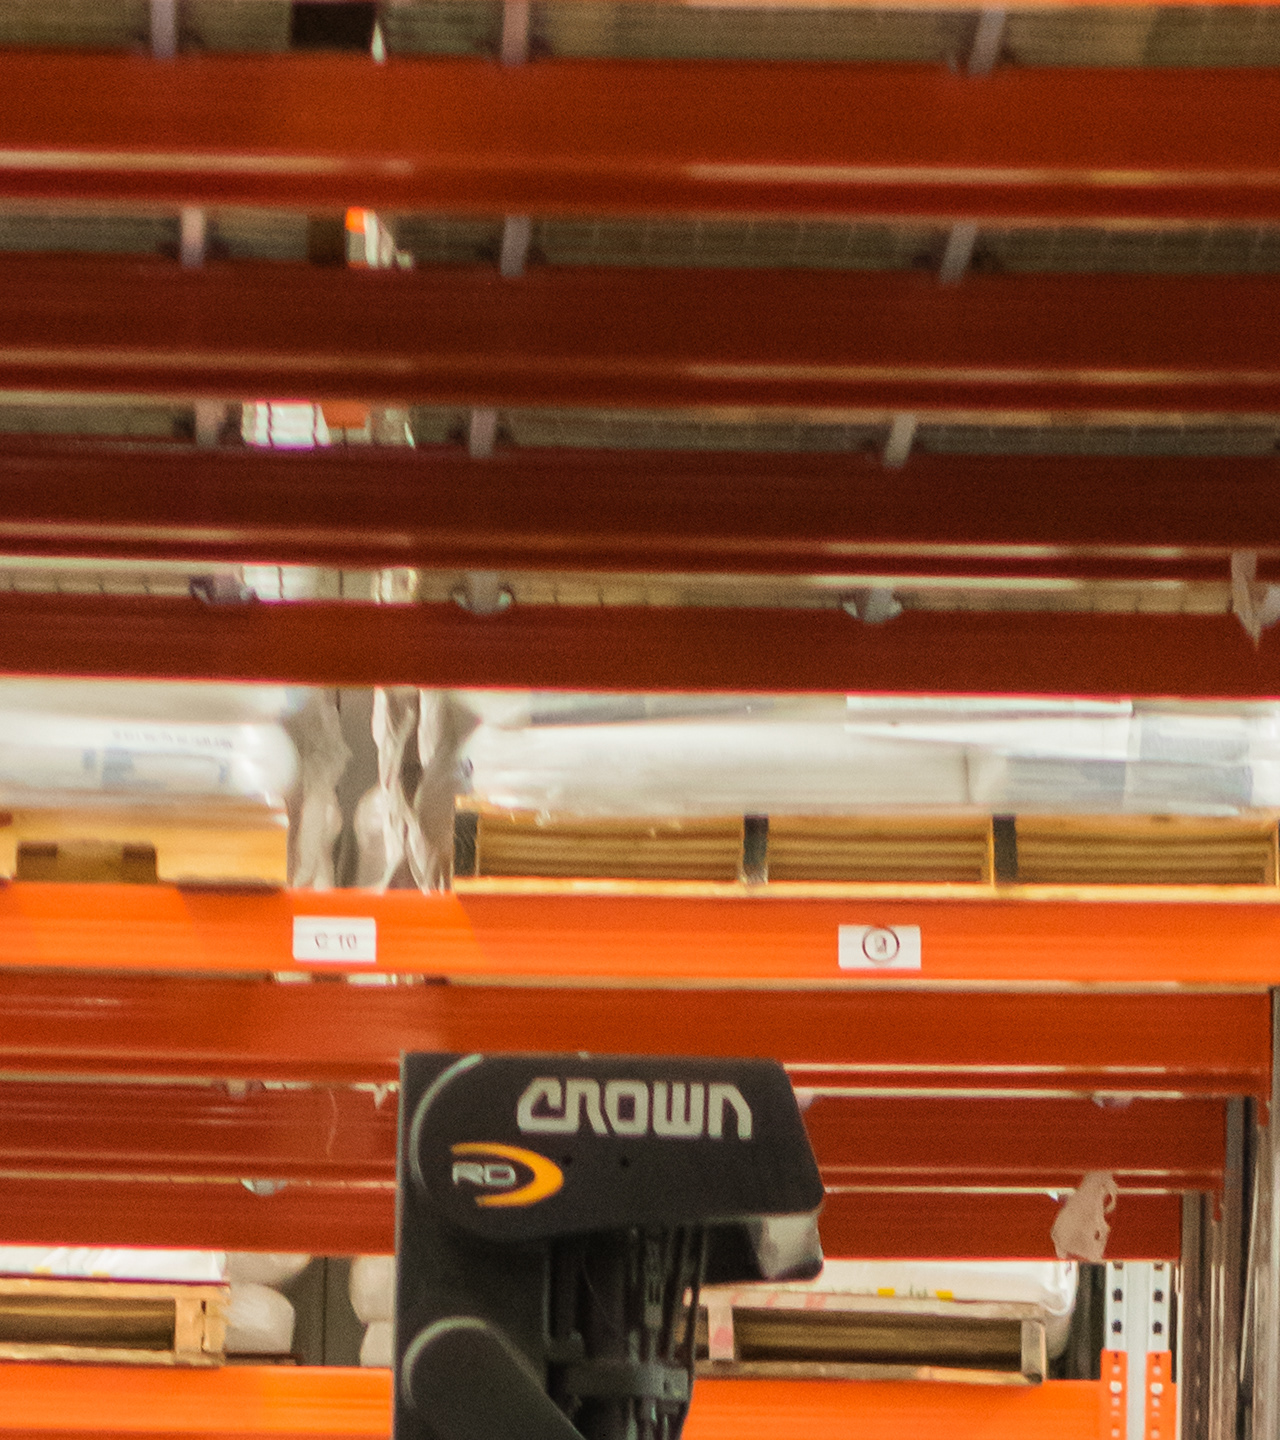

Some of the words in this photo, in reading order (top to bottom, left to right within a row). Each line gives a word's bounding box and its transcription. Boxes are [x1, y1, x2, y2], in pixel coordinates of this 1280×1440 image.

[337, 932, 358, 950] 10
[516, 1076, 753, 1142] CROWN
[450, 1161, 517, 1187] RD
